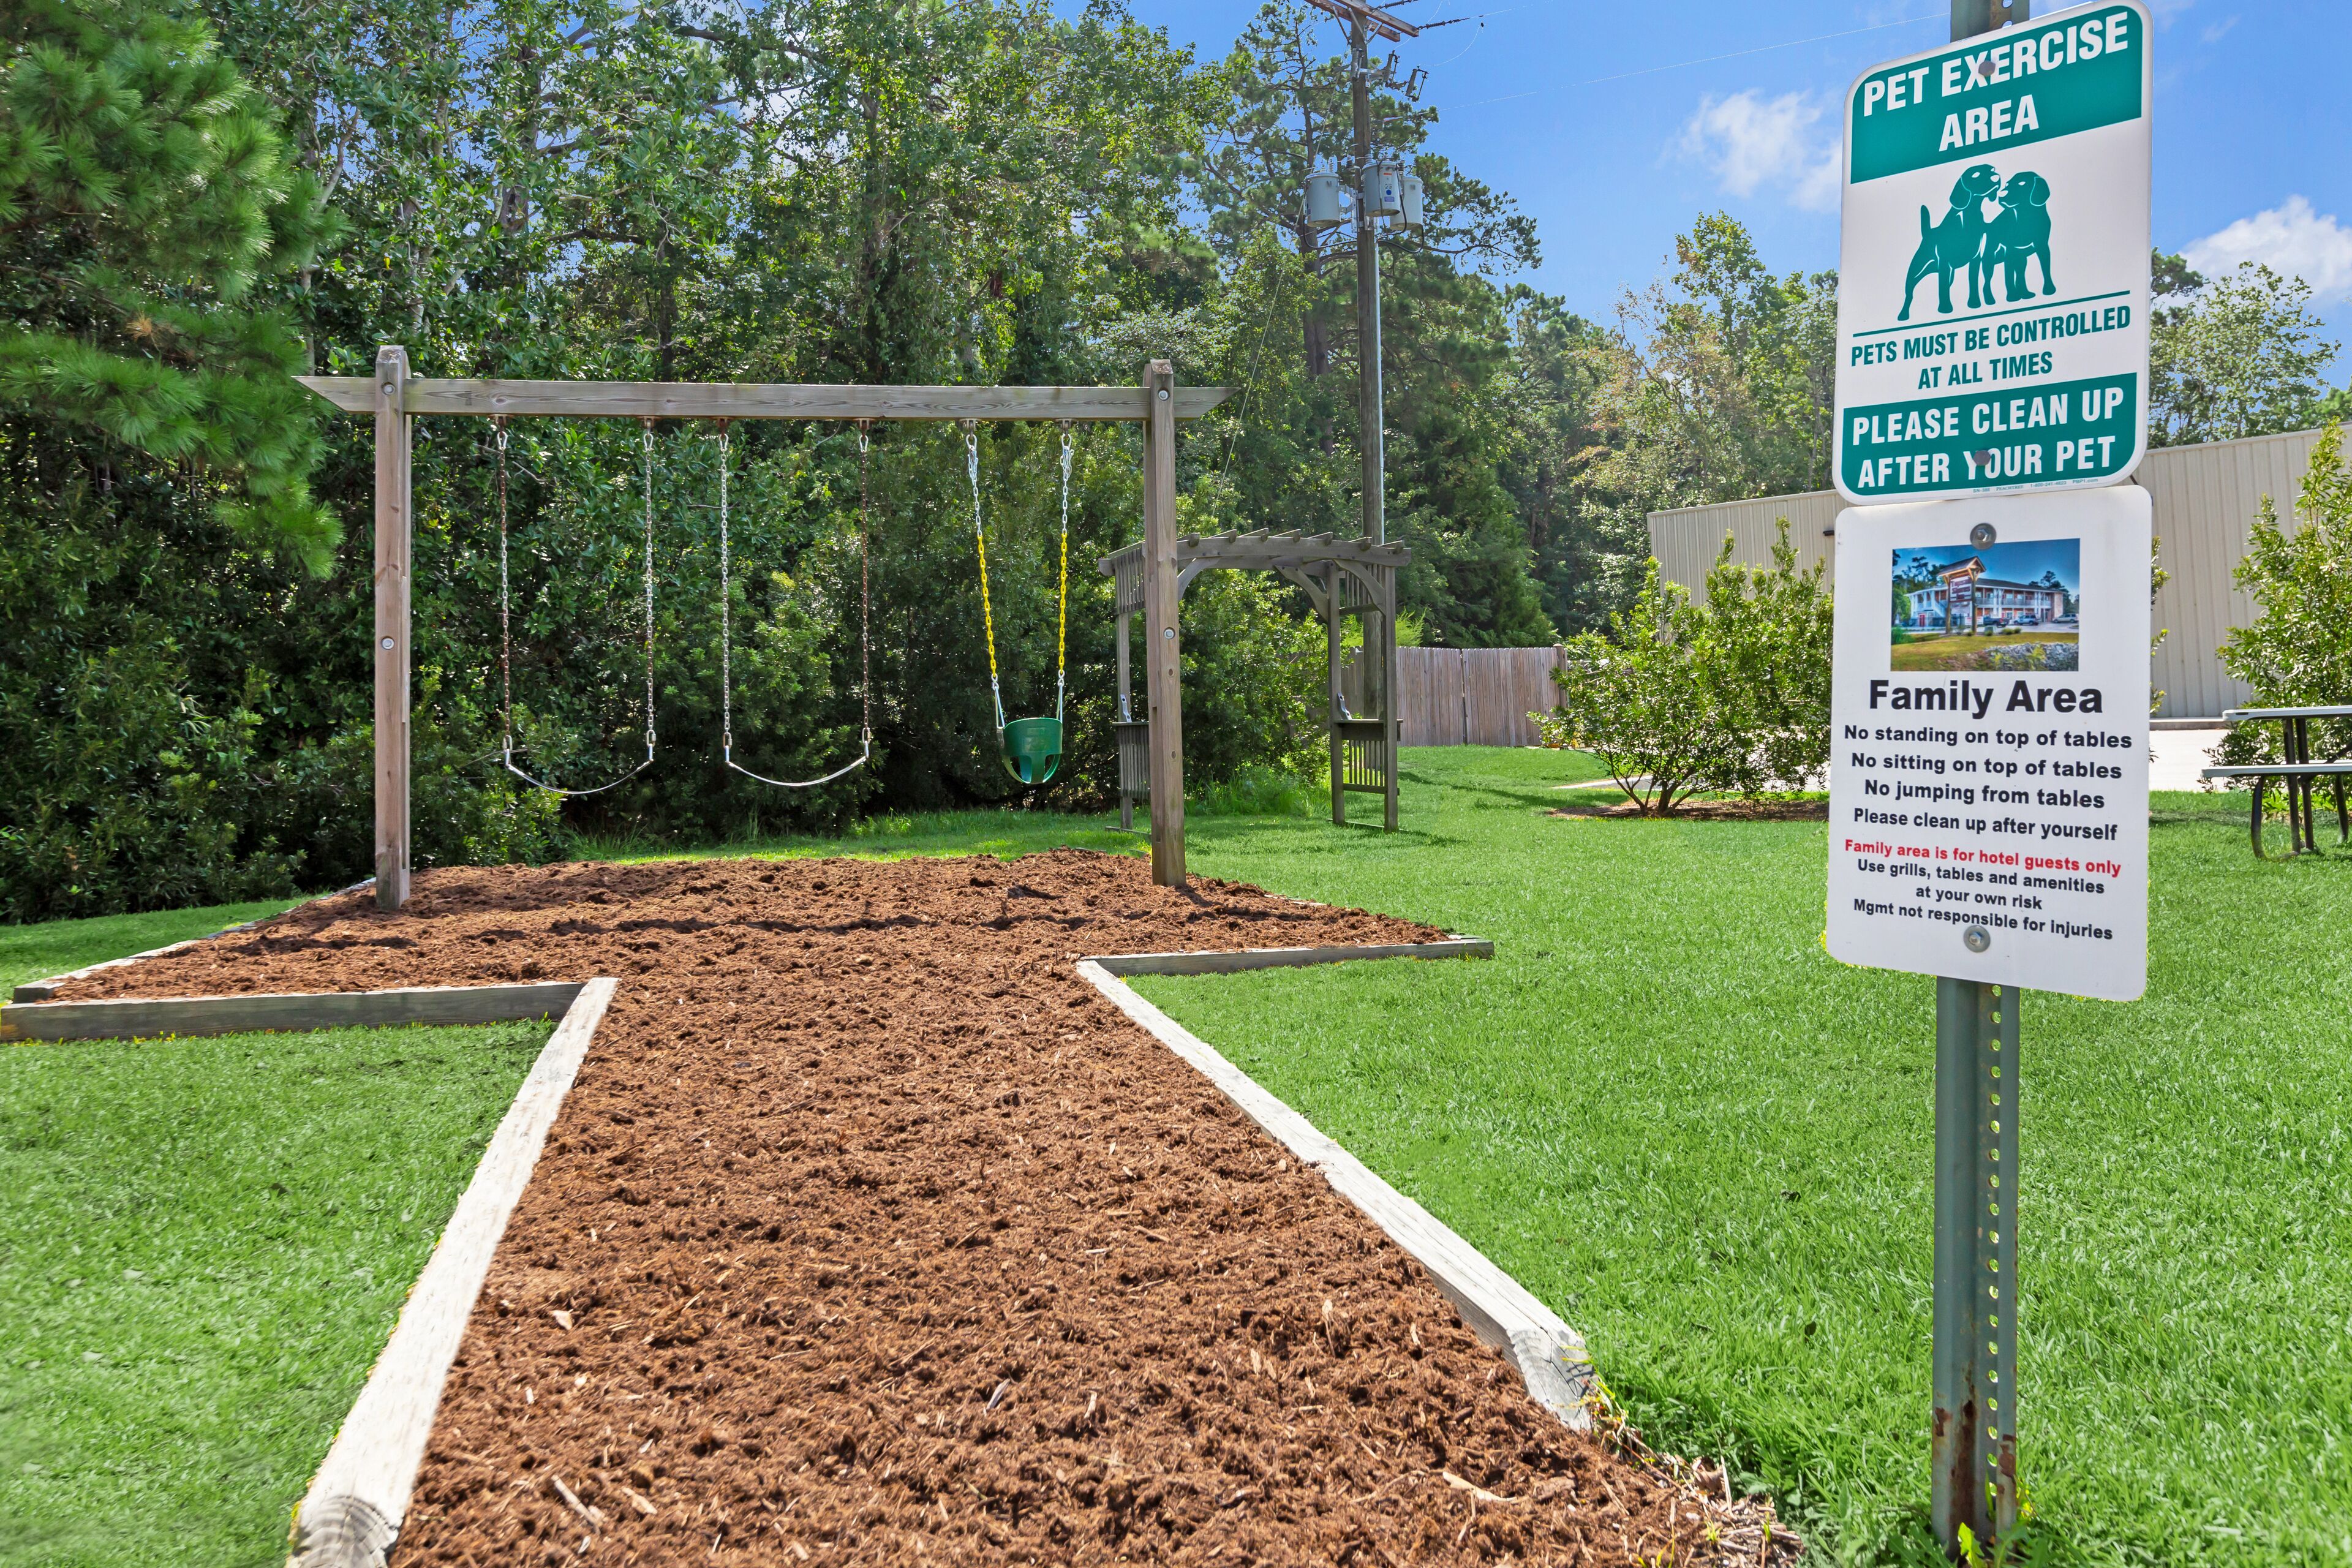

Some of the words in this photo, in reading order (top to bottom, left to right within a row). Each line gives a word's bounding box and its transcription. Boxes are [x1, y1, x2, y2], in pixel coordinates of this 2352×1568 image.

[1864, 67, 1929, 116] PET
[1942, 12, 2127, 97] EXERCISE
[1939, 95, 2038, 151] AREA
[1852, 341, 1897, 366] PETS
[1904, 332, 1958, 360] MUST
[1966, 328, 1989, 351] BE
[1997, 306, 2130, 347] CONTROLLED
[1918, 367, 1942, 389] AT
[1948, 362, 1982, 385] ALL
[1989, 352, 2052, 380] TIMES
[1853, 407, 1958, 445] PLEASE
[1973, 394, 2067, 434] CLEAN
[2082, 388, 2123, 421] UP
[1858, 453, 1949, 488] AFTER
[1964, 444, 2041, 480] YOUR
[2057, 436, 2115, 471] PET
[1870, 680, 1994, 719] Family
[2006, 680, 2102, 713] Area
[1845, 725, 1868, 739] No
[1875, 727, 1957, 746] standing
[1966, 732, 1988, 743] on
[1996, 729, 2029, 748] top
[2037, 730, 2057, 745] of
[2064, 731, 2132, 748] tables
[1852, 753, 1876, 767] No
[1883, 755, 1945, 774] sitting
[1953, 760, 1976, 772] on
[1985, 758, 2017, 777] top
[2026, 760, 2046, 775] of
[2053, 761, 2122, 778] tables
[1865, 780, 1890, 796] No
[1896, 781, 1974, 804] jumping
[1982, 785, 2029, 804] from
[2037, 789, 2104, 808] tables
[1855, 808, 1907, 825] Please
[1914, 812, 1959, 829] clean
[1966, 819, 1986, 834] up
[1992, 818, 2035, 834] after
[2041, 824, 2117, 840] yourself
[1845, 840, 1892, 858] Family
[1898, 846, 1929, 858] area
[1936, 846, 1947, 859] is
[1953, 848, 1974, 861] for
[1980, 850, 2018, 865] hotel
[2025, 857, 2079, 870] guests
[2086, 860, 2120, 878] only
[1858, 859, 1885, 872] Use
[1890, 863, 1930, 880] grills,
[1937, 867, 1983, 882] tables
[1989, 873, 2017, 885] and
[2023, 877, 2104, 894] amenities
[1916, 886, 1930, 898] at
[1936, 890, 1969, 902] your
[1975, 894, 2006, 905] own
[2013, 895, 2042, 910] risk
[1855, 899, 1893, 915] Mgmt
[1899, 907, 1922, 918] not
[1928, 910, 2018, 929] responsible
[2023, 917, 2045, 932] for
[2051, 920, 2113, 940] injuries
